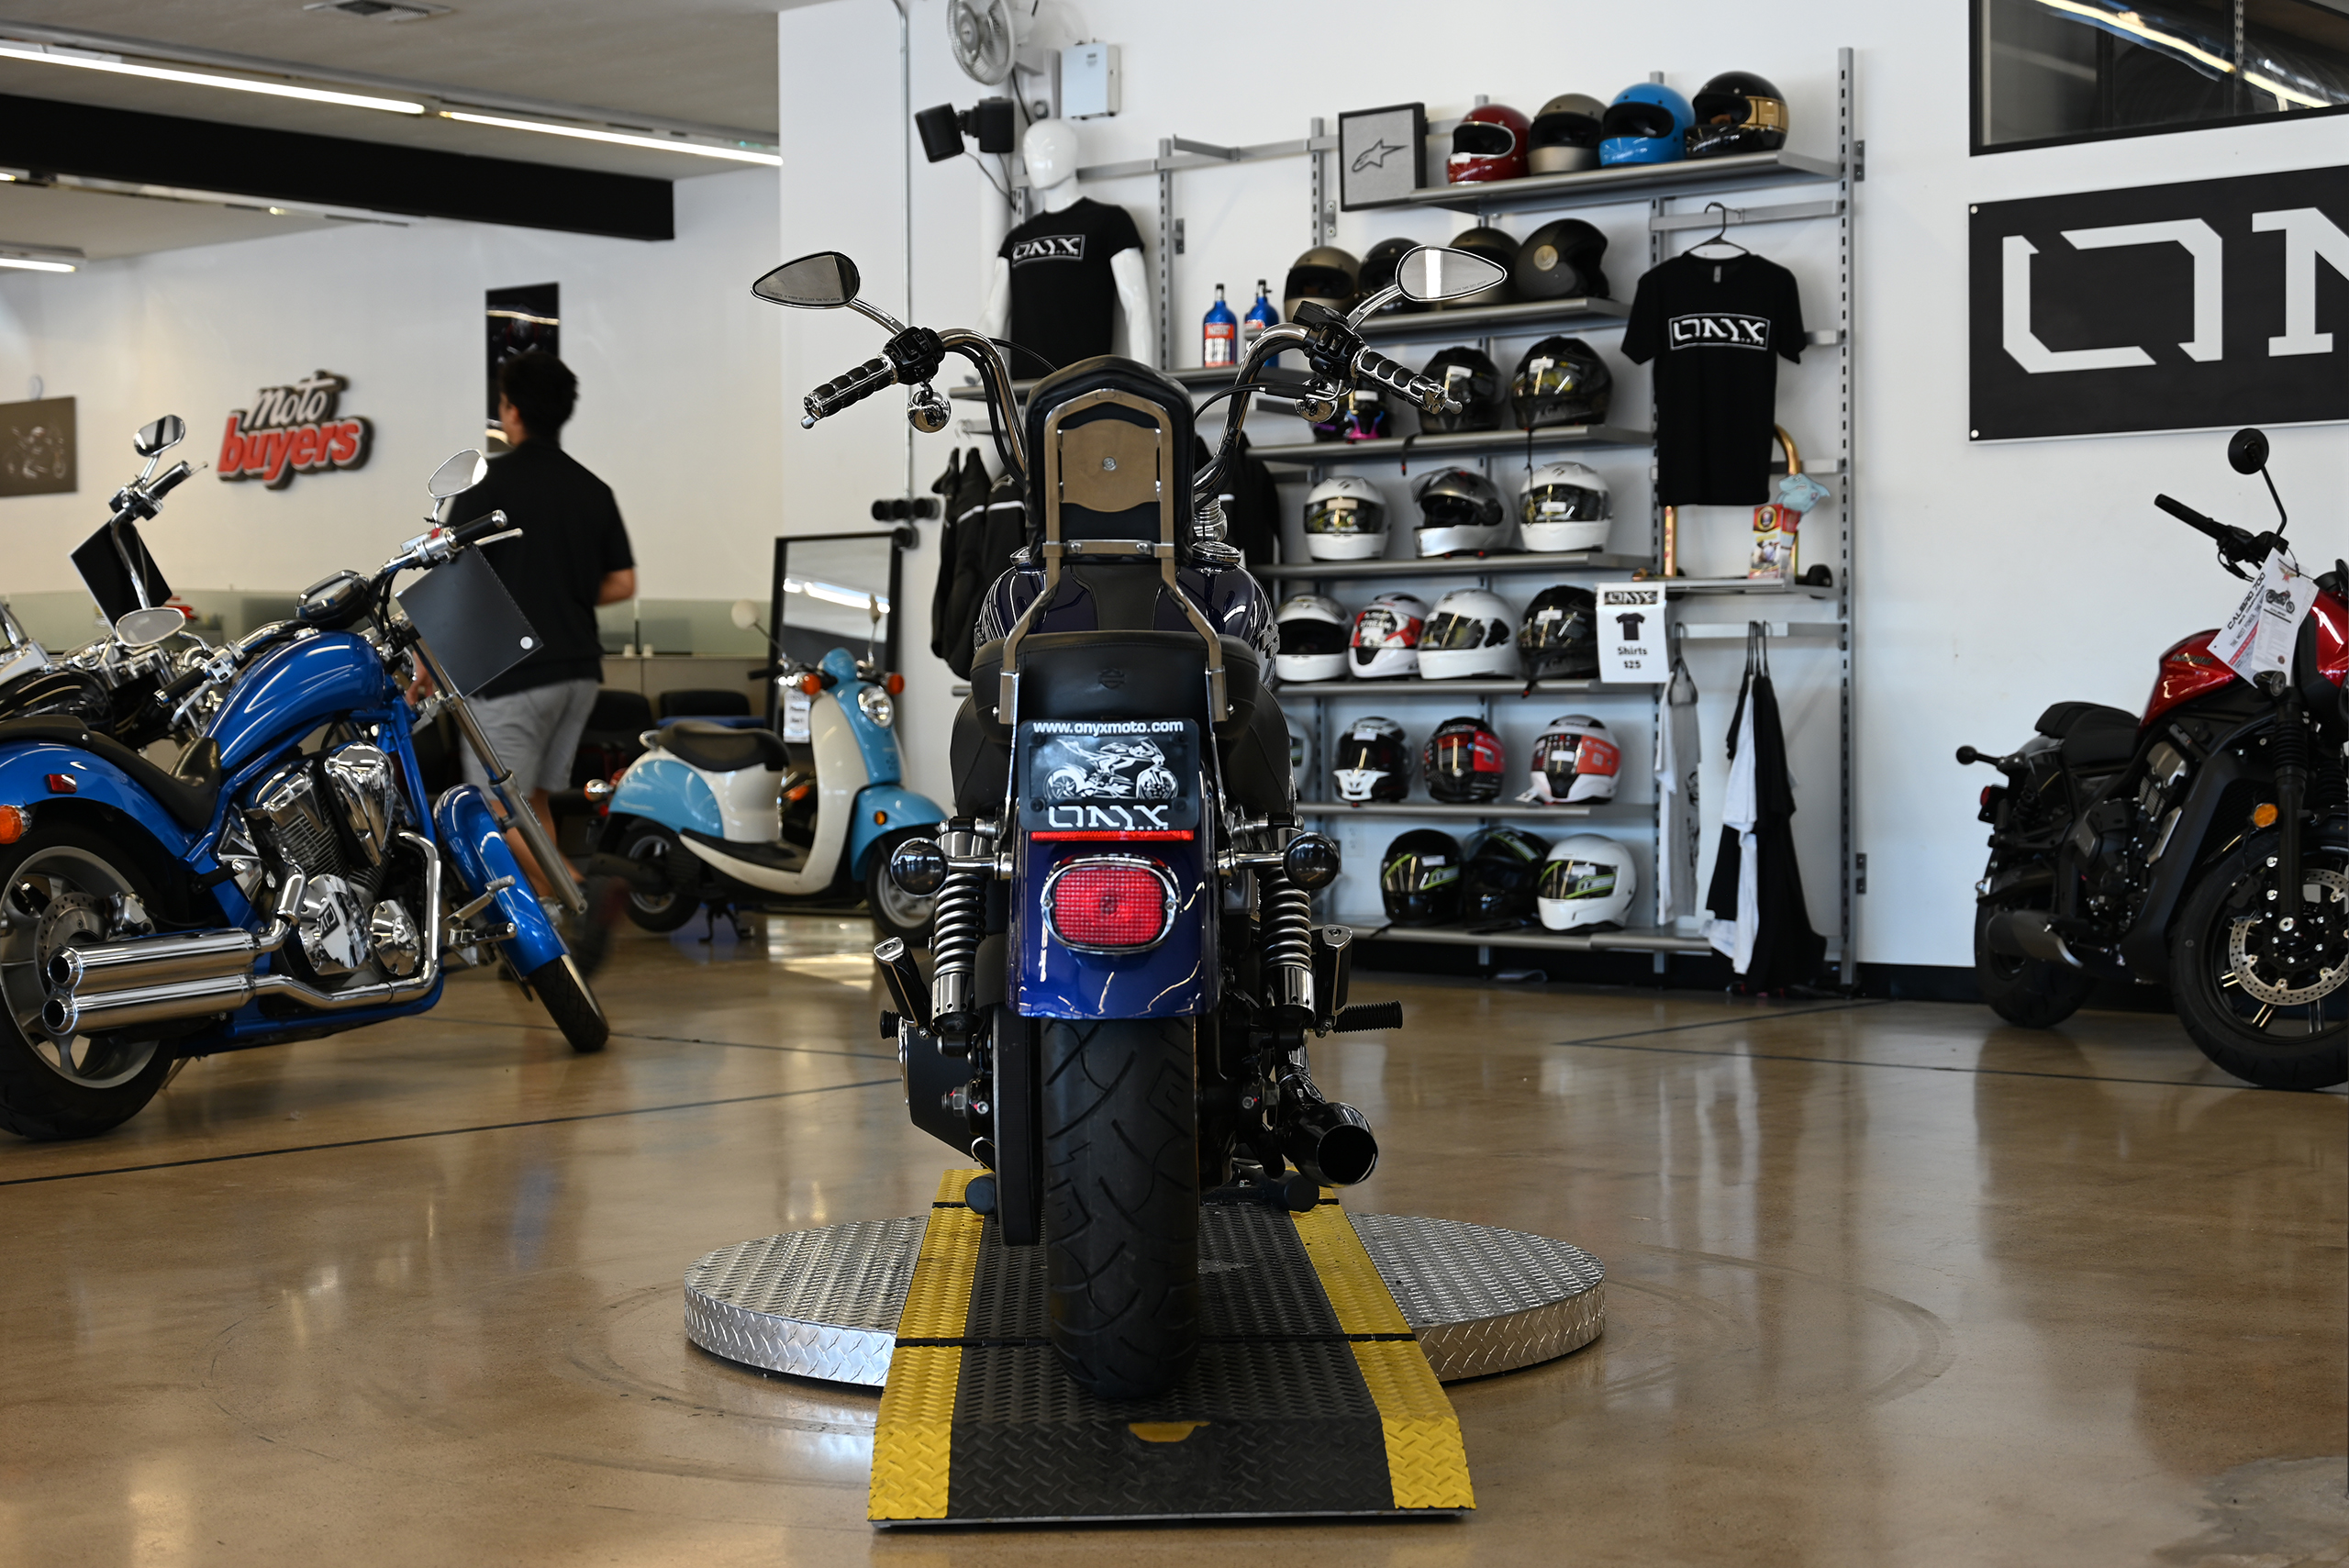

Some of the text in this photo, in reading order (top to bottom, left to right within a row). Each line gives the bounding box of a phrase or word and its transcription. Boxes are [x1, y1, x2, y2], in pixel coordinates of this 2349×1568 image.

[1012, 237, 1080, 261] ONYX
[1673, 317, 1765, 342] ONYX
[217, 414, 362, 485] buyers
[1608, 591, 1653, 605] ONYX
[2227, 590, 2254, 630] CALIBRO
[2252, 572, 2266, 591] 700
[1617, 646, 1648, 655] Shirts
[1032, 721, 1184, 737] www.onyxmoto.com
[1048, 805, 1169, 830] ONYX
